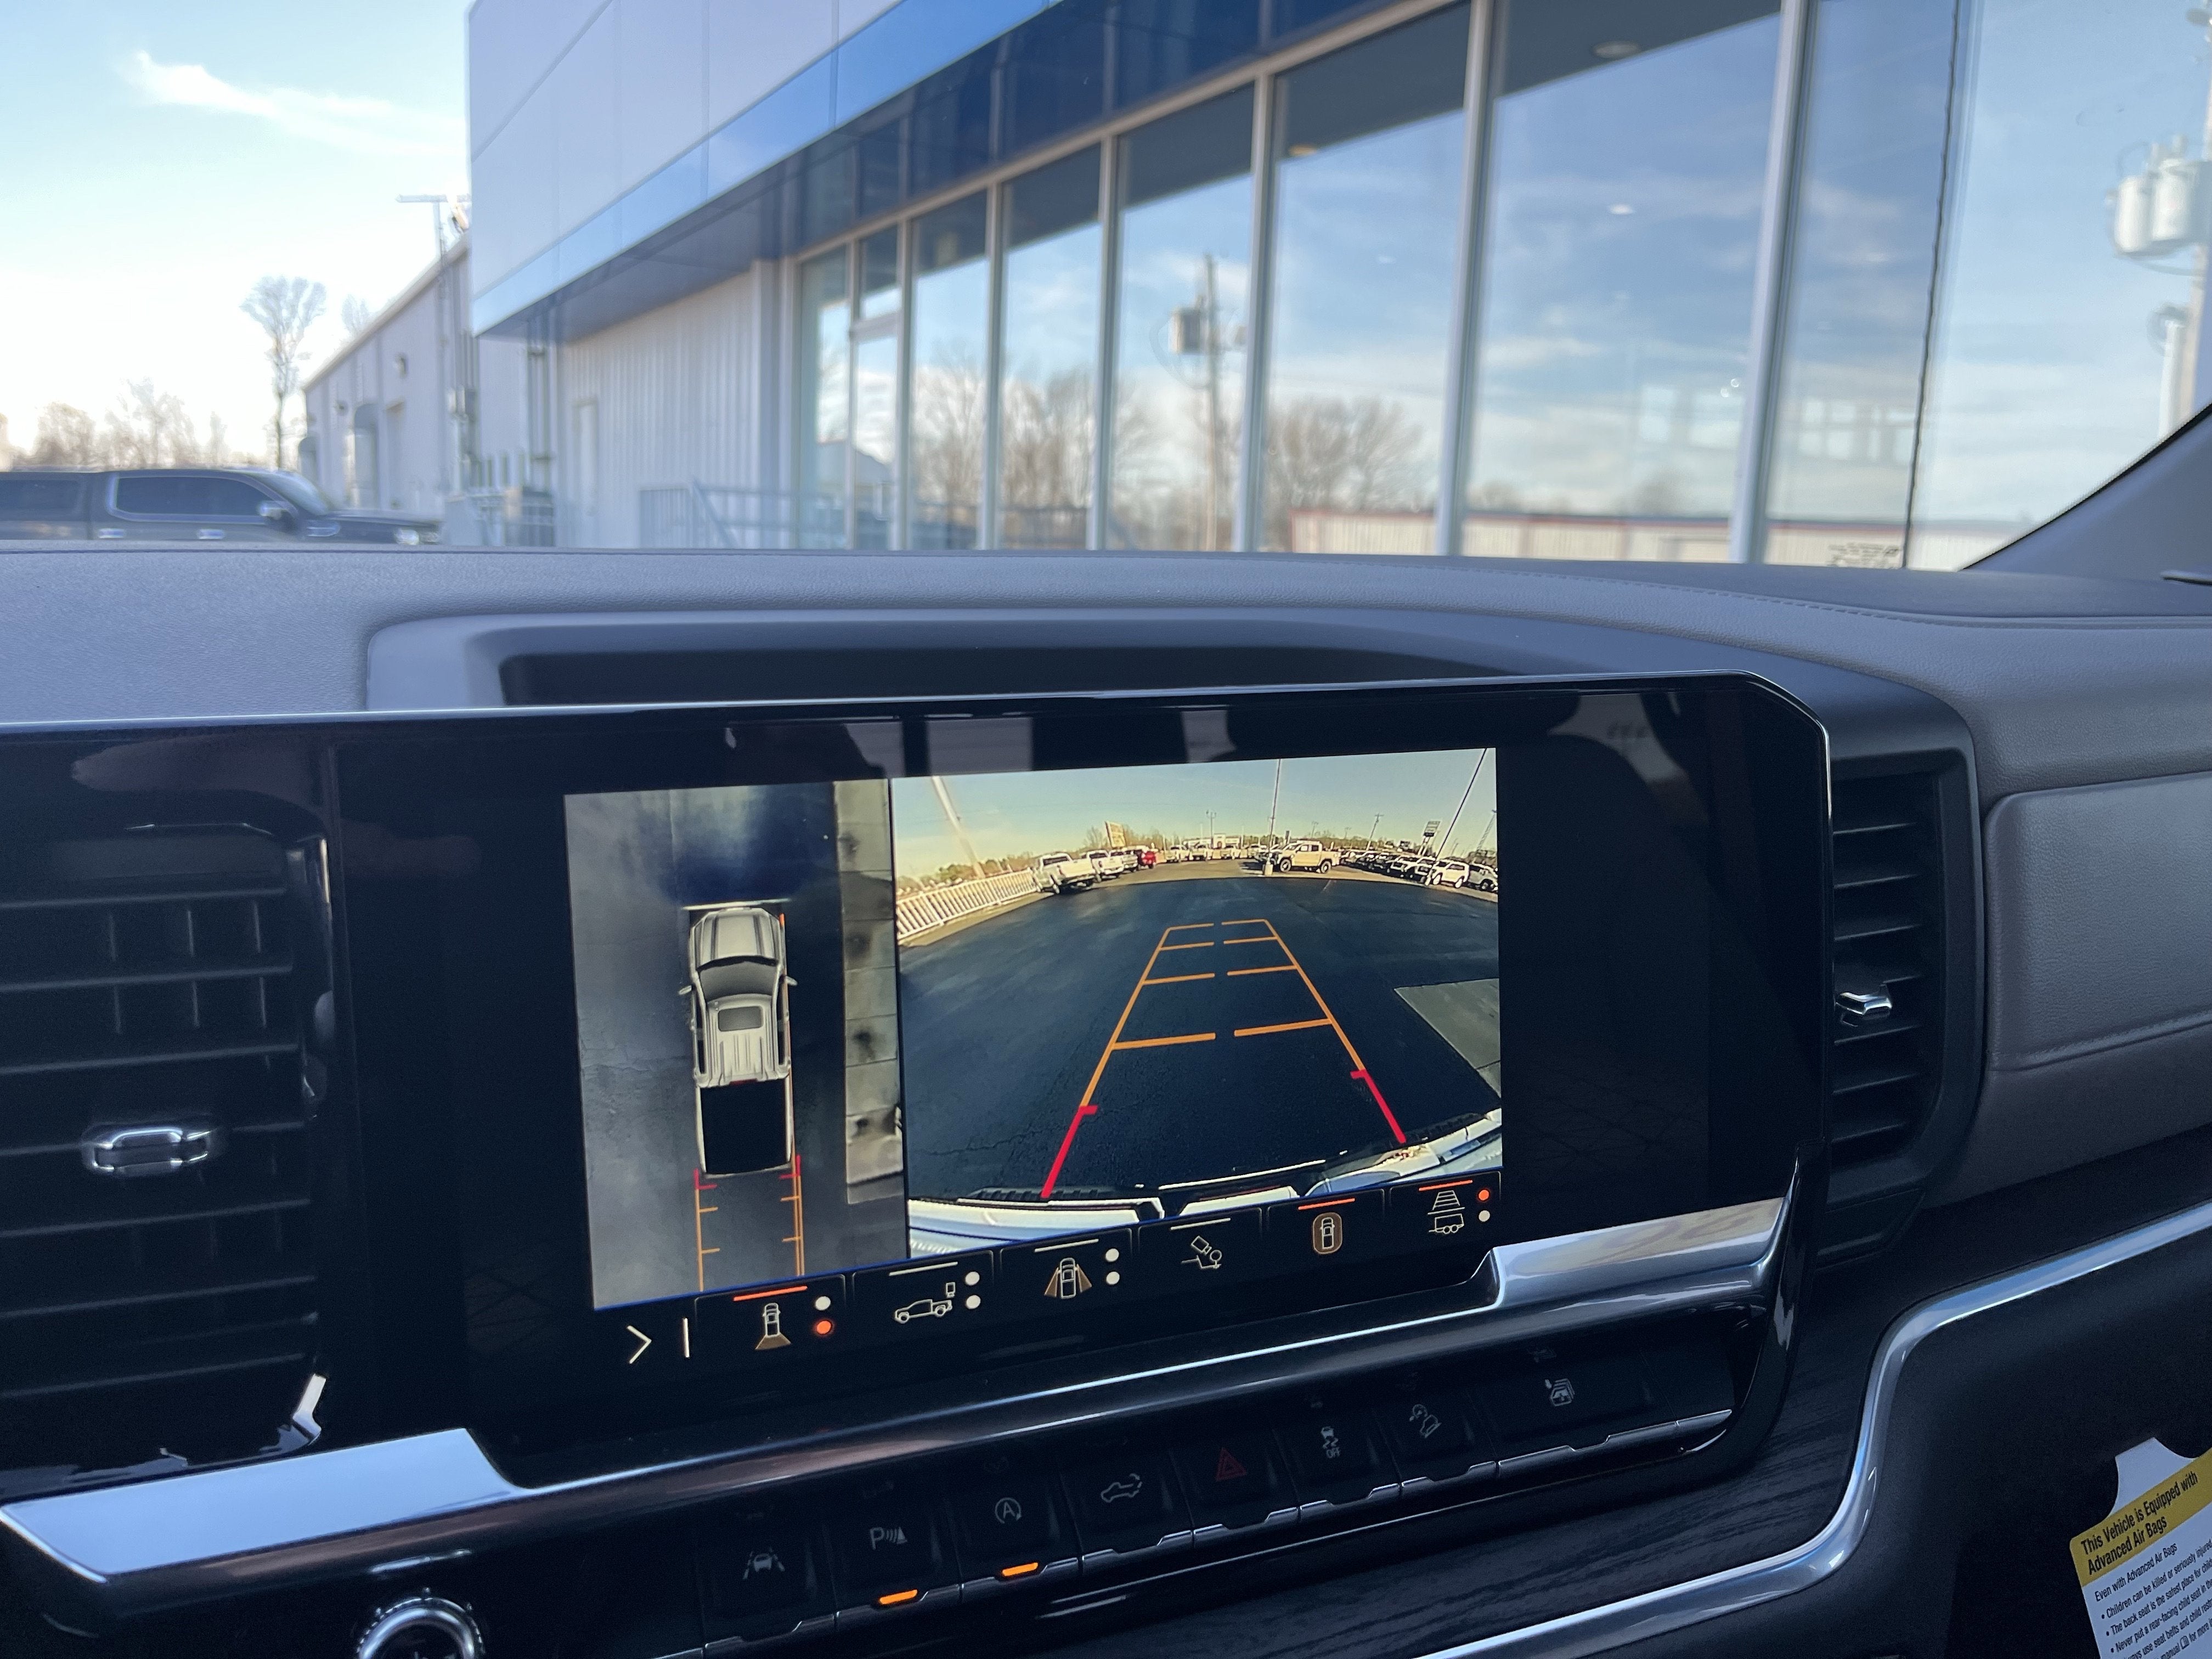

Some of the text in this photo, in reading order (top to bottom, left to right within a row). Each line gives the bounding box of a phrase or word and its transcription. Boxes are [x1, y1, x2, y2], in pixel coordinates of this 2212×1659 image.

[2081, 1471, 2198, 1555] This Vehicle is Equipped with
[2088, 1516, 2167, 1576] Advanced Air Bags
[2095, 1543, 2177, 1601] Even with Advanced Air Bags
[2107, 1598, 2132, 1618] Children
[2132, 1590, 2144, 1602] can
[2143, 1584, 2151, 1595] be
[2151, 1572, 2167, 1589] killed
[2167, 1569, 2173, 1579] or
[2174, 1553, 2196, 1574] seriously
[2111, 1623, 2123, 1635] The
[2123, 1613, 2138, 1628] back
[2138, 1603, 2151, 1618] seat
[2150, 1601, 2156, 1610] is
[2155, 1595, 2165, 1607] the
[2165, 1582, 2182, 1600] safest
[2181, 1574, 2194, 1591] place
[2202, 1557, 2212, 1573] child
[2115, 1635, 2133, 1652] Never
[2134, 1627, 2145, 1643] put
[2144, 1626, 2149, 1634] a
[2149, 1606, 2179, 1631] rear-facing
[2178, 1595, 2191, 1611] child
[2190, 1587, 2202, 1601] seat
[2200, 1584, 2206, 1594] in
[2142, 1643, 2153, 1655] use
[2153, 1633, 2166, 1648] seat
[2165, 1626, 2180, 1639] belts
[2180, 1616, 2190, 1630] and
[2190, 1606, 2202, 1622] child
[2197, 1622, 2210, 1638] more
